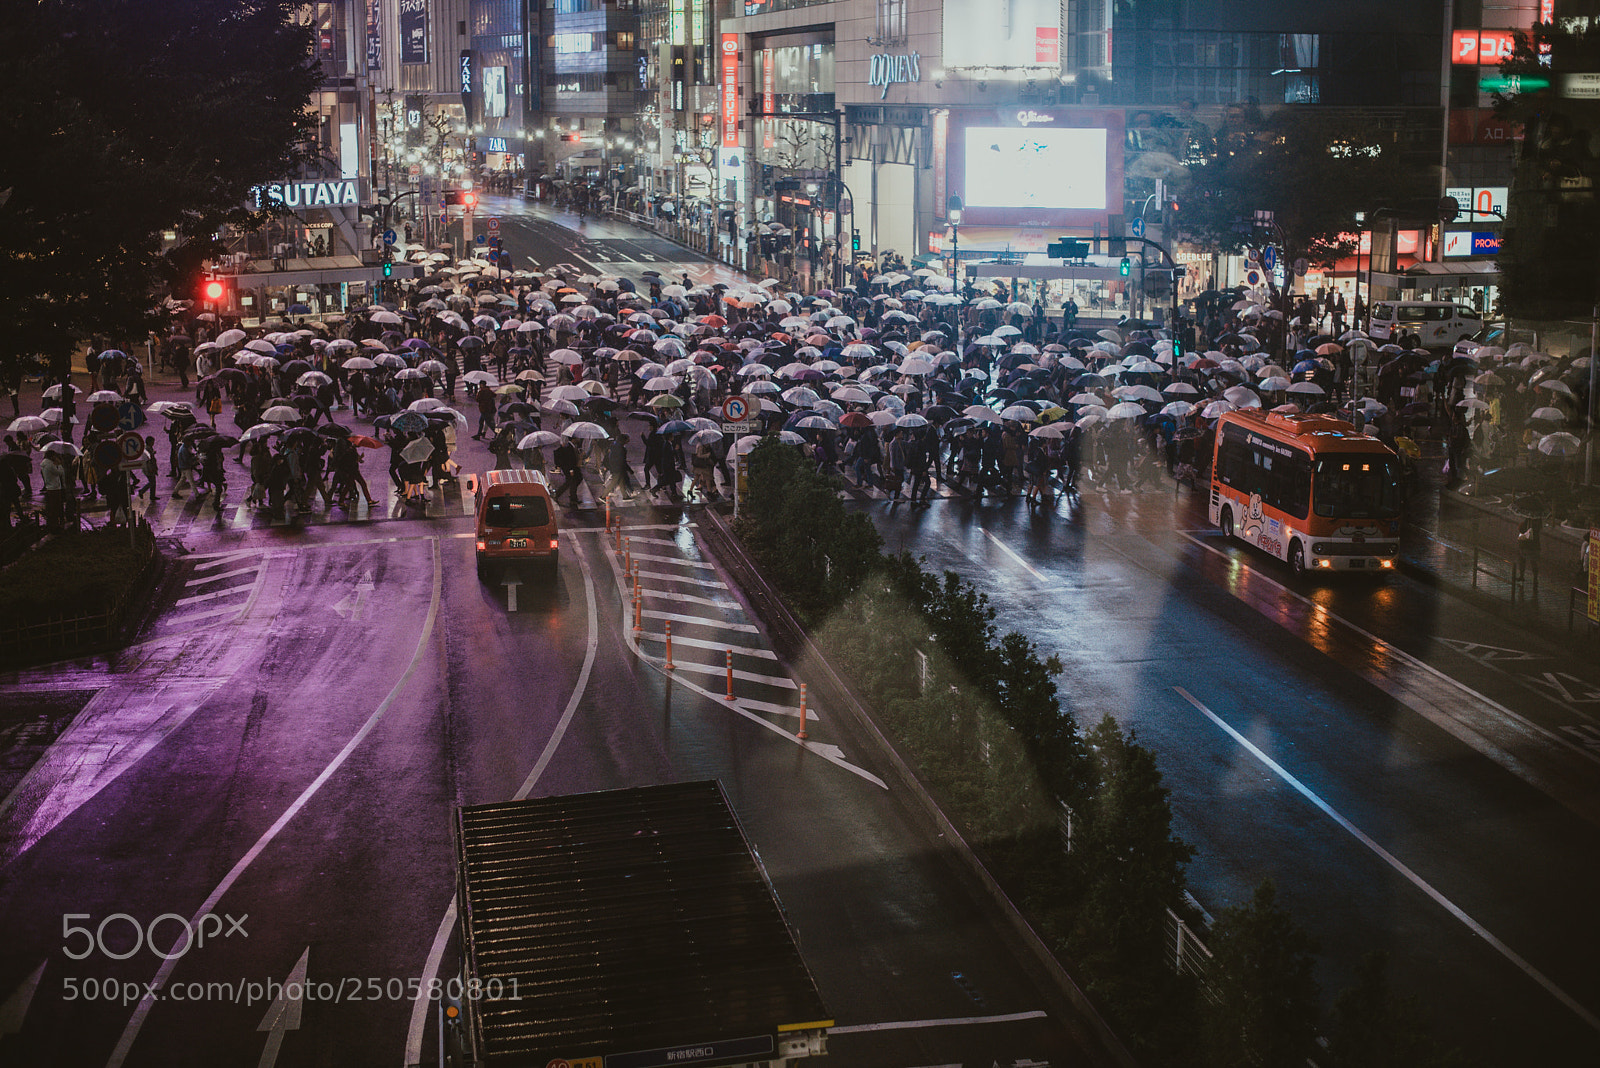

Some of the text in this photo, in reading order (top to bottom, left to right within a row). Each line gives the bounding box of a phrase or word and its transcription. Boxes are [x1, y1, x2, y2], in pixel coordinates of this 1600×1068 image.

[1459, 37, 1513, 57] アコム
[462, 56, 471, 93] ZARA
[725, 66, 736, 141] 三菱東京UFJ銀行
[489, 138, 507, 152] ZARA
[250, 181, 359, 209] TSUTAYA
